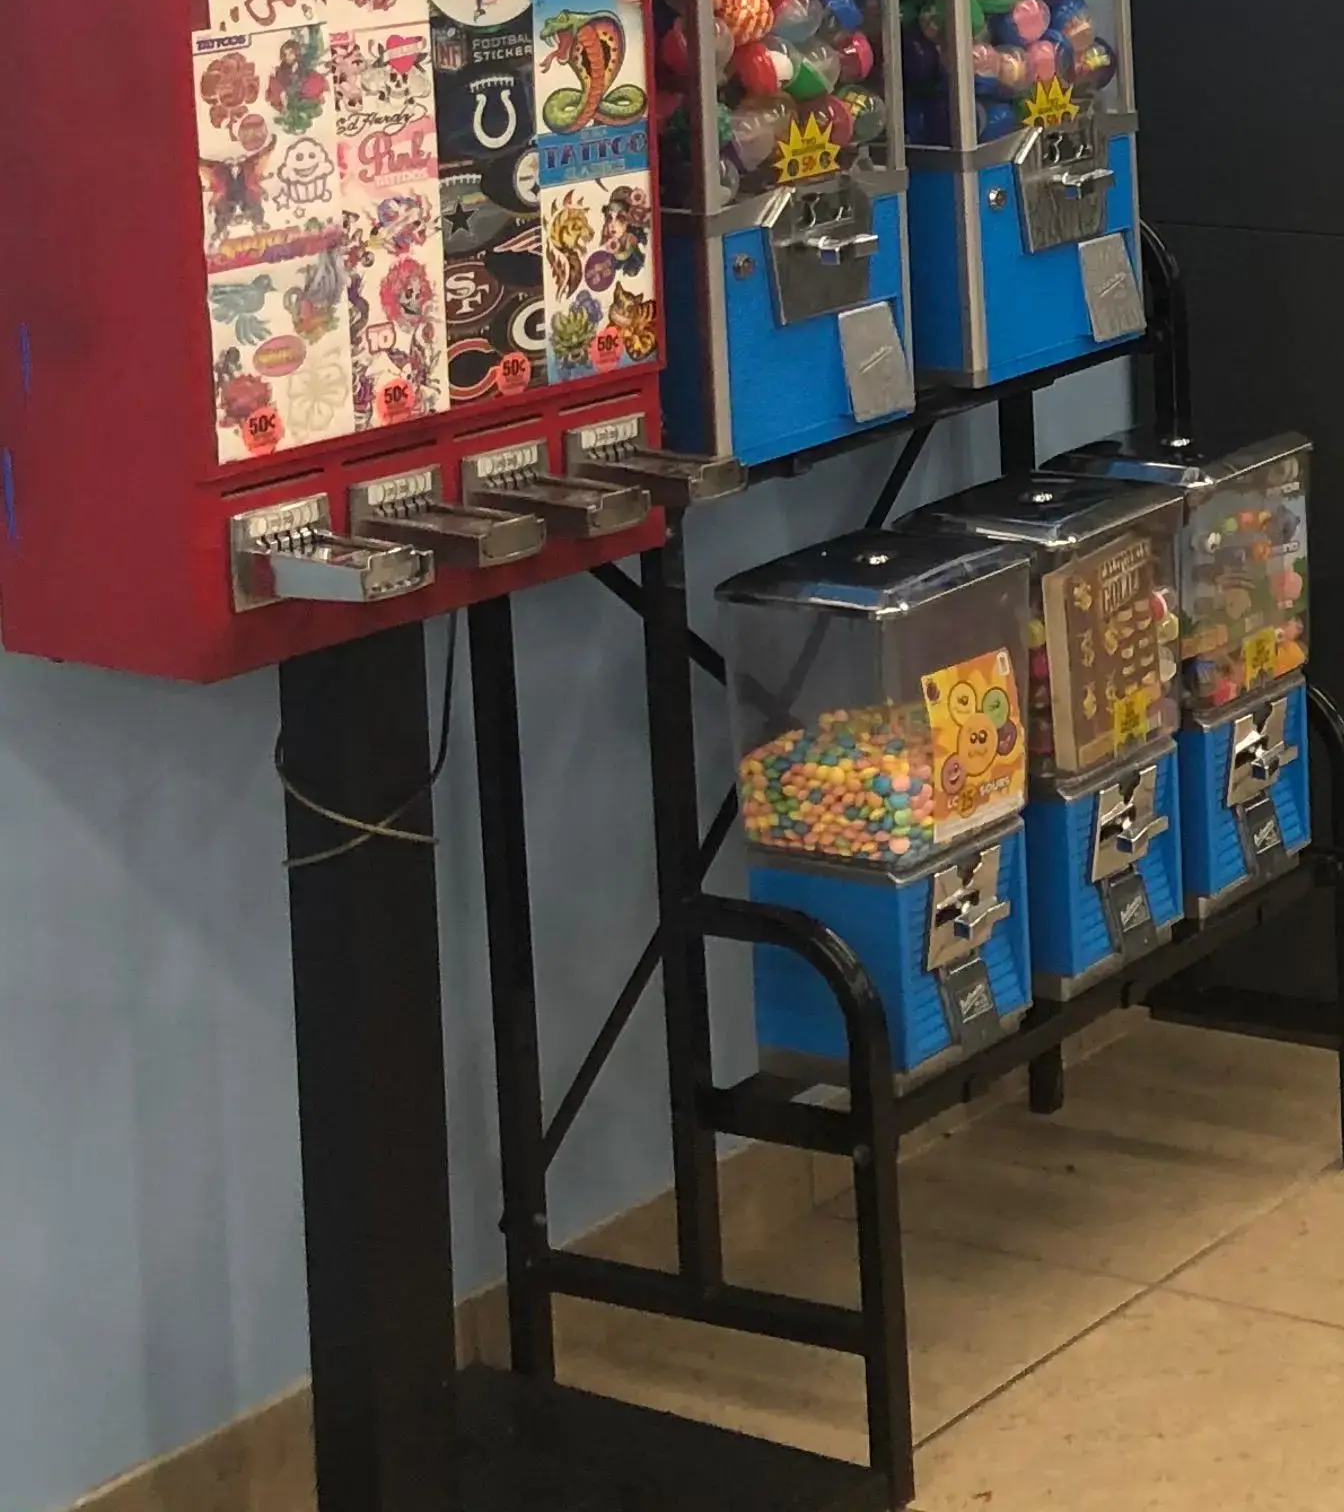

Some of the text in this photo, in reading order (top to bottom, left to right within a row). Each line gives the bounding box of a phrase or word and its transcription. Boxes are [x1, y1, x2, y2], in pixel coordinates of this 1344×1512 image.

[472, 34, 532, 50] FOOTBAL
[473, 45, 532, 63] STICKER
[597, 334, 619, 352] 50¢
[502, 360, 526, 377] 50¢
[384, 386, 409, 404] 50¢
[249, 414, 276, 434] 50¢
